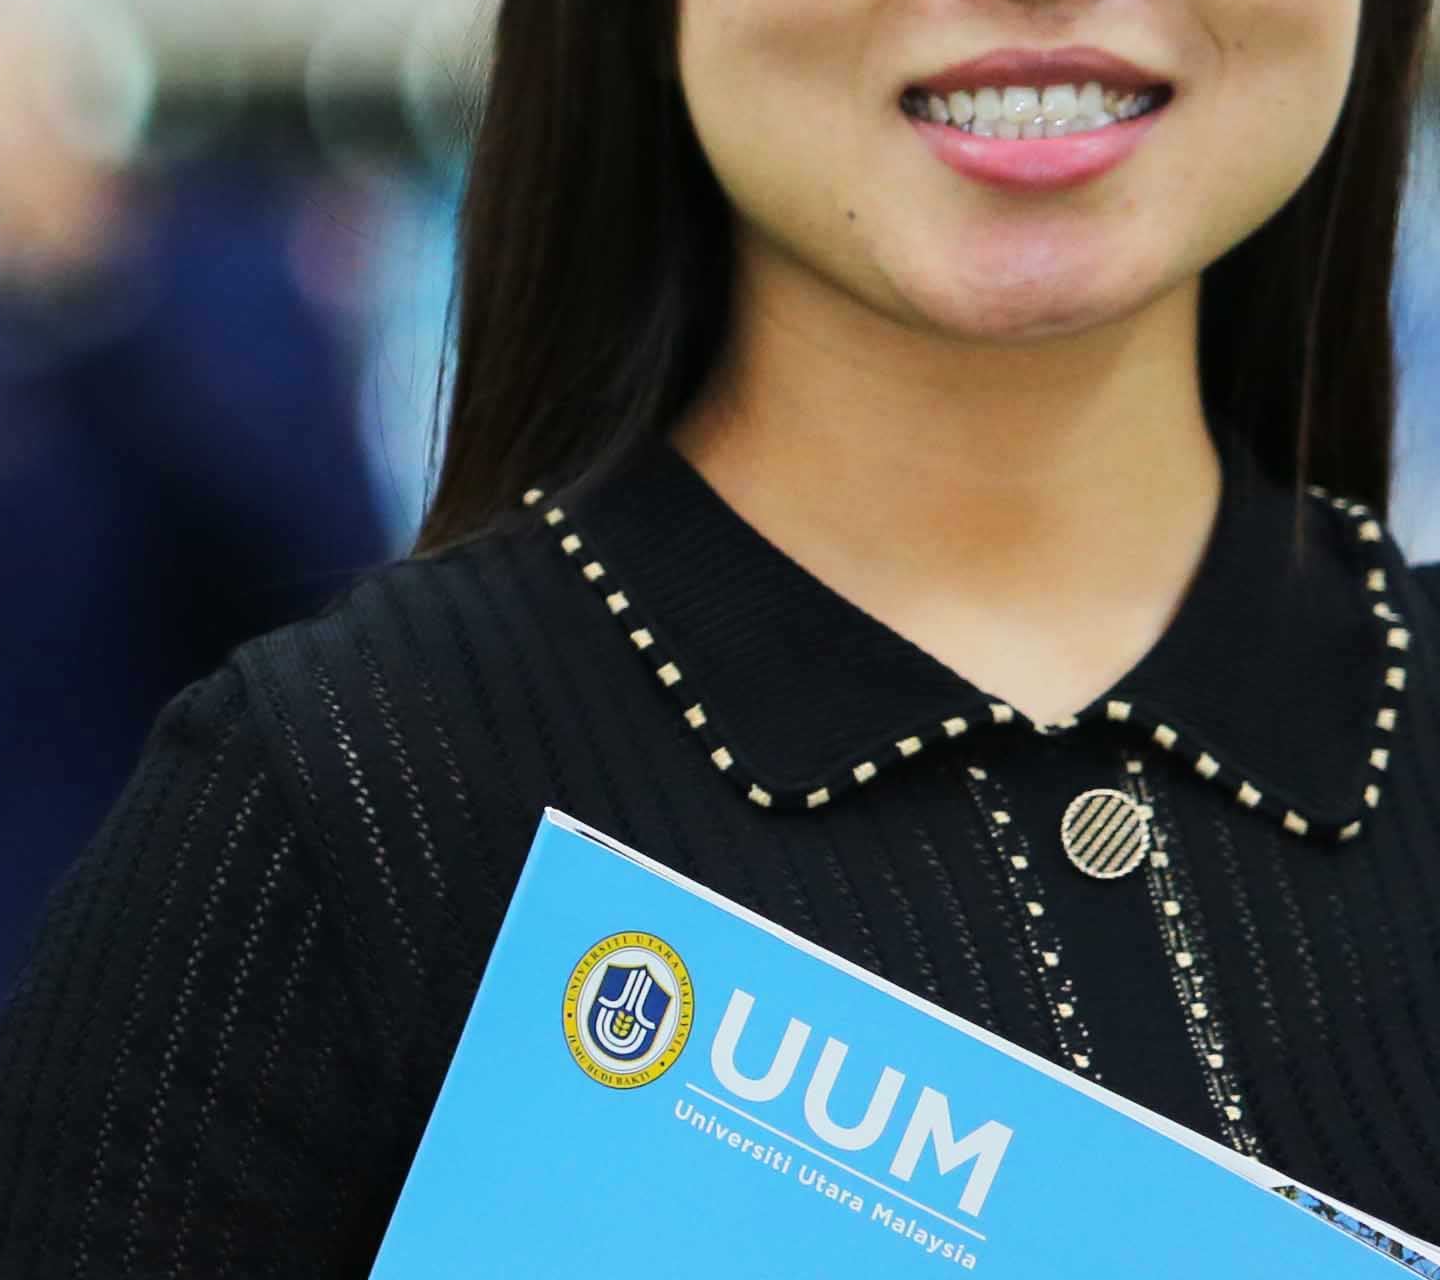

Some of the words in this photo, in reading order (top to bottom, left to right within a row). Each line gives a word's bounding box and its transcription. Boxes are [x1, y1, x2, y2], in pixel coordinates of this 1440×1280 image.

[565, 934, 629, 1003] UNIVERSITI
[635, 934, 679, 970] UTARA
[674, 1099, 792, 1174] Universiti
[798, 1165, 864, 1212] Utara
[871, 1203, 977, 1269] Malaysia
[710, 988, 1014, 1217] UUM
